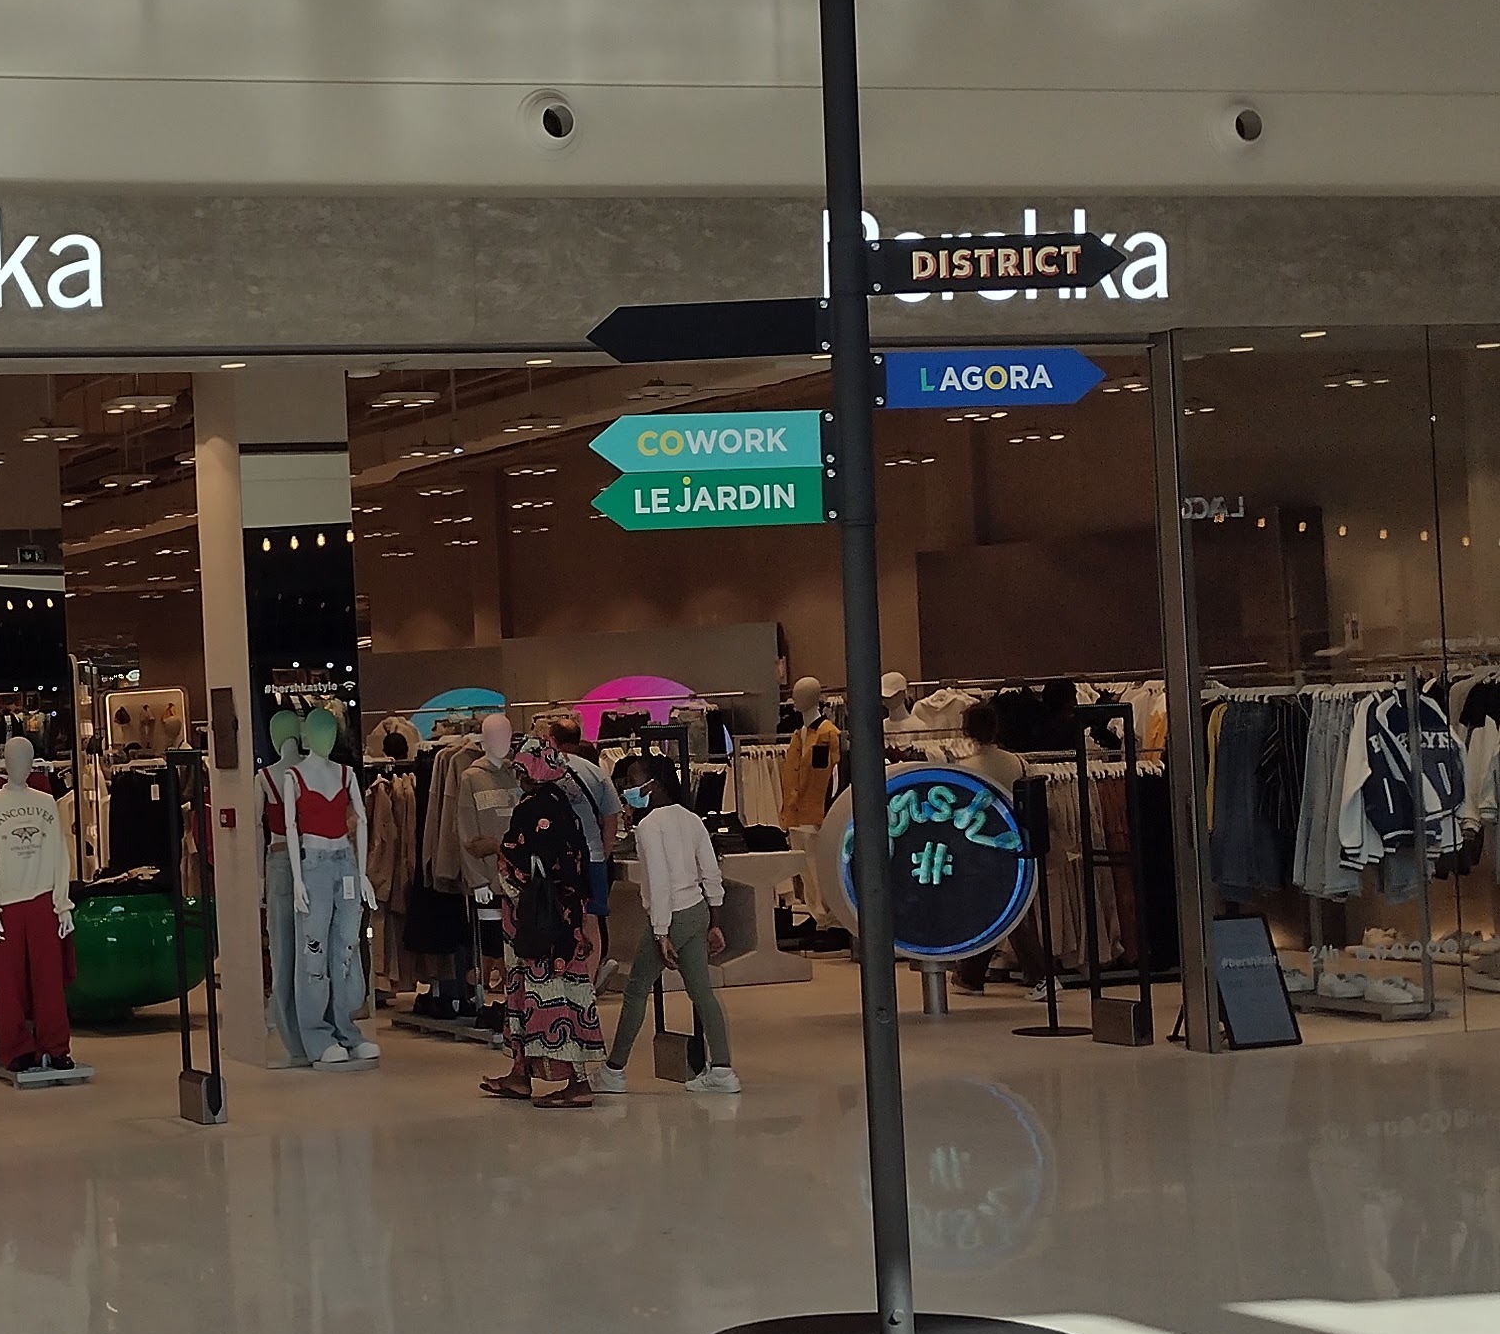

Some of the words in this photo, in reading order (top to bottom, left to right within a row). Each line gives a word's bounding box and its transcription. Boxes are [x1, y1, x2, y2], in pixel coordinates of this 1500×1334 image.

[911, 244, 1083, 281] DISTRICT
[636, 427, 788, 457] COWORK
[634, 487, 671, 514] LE
